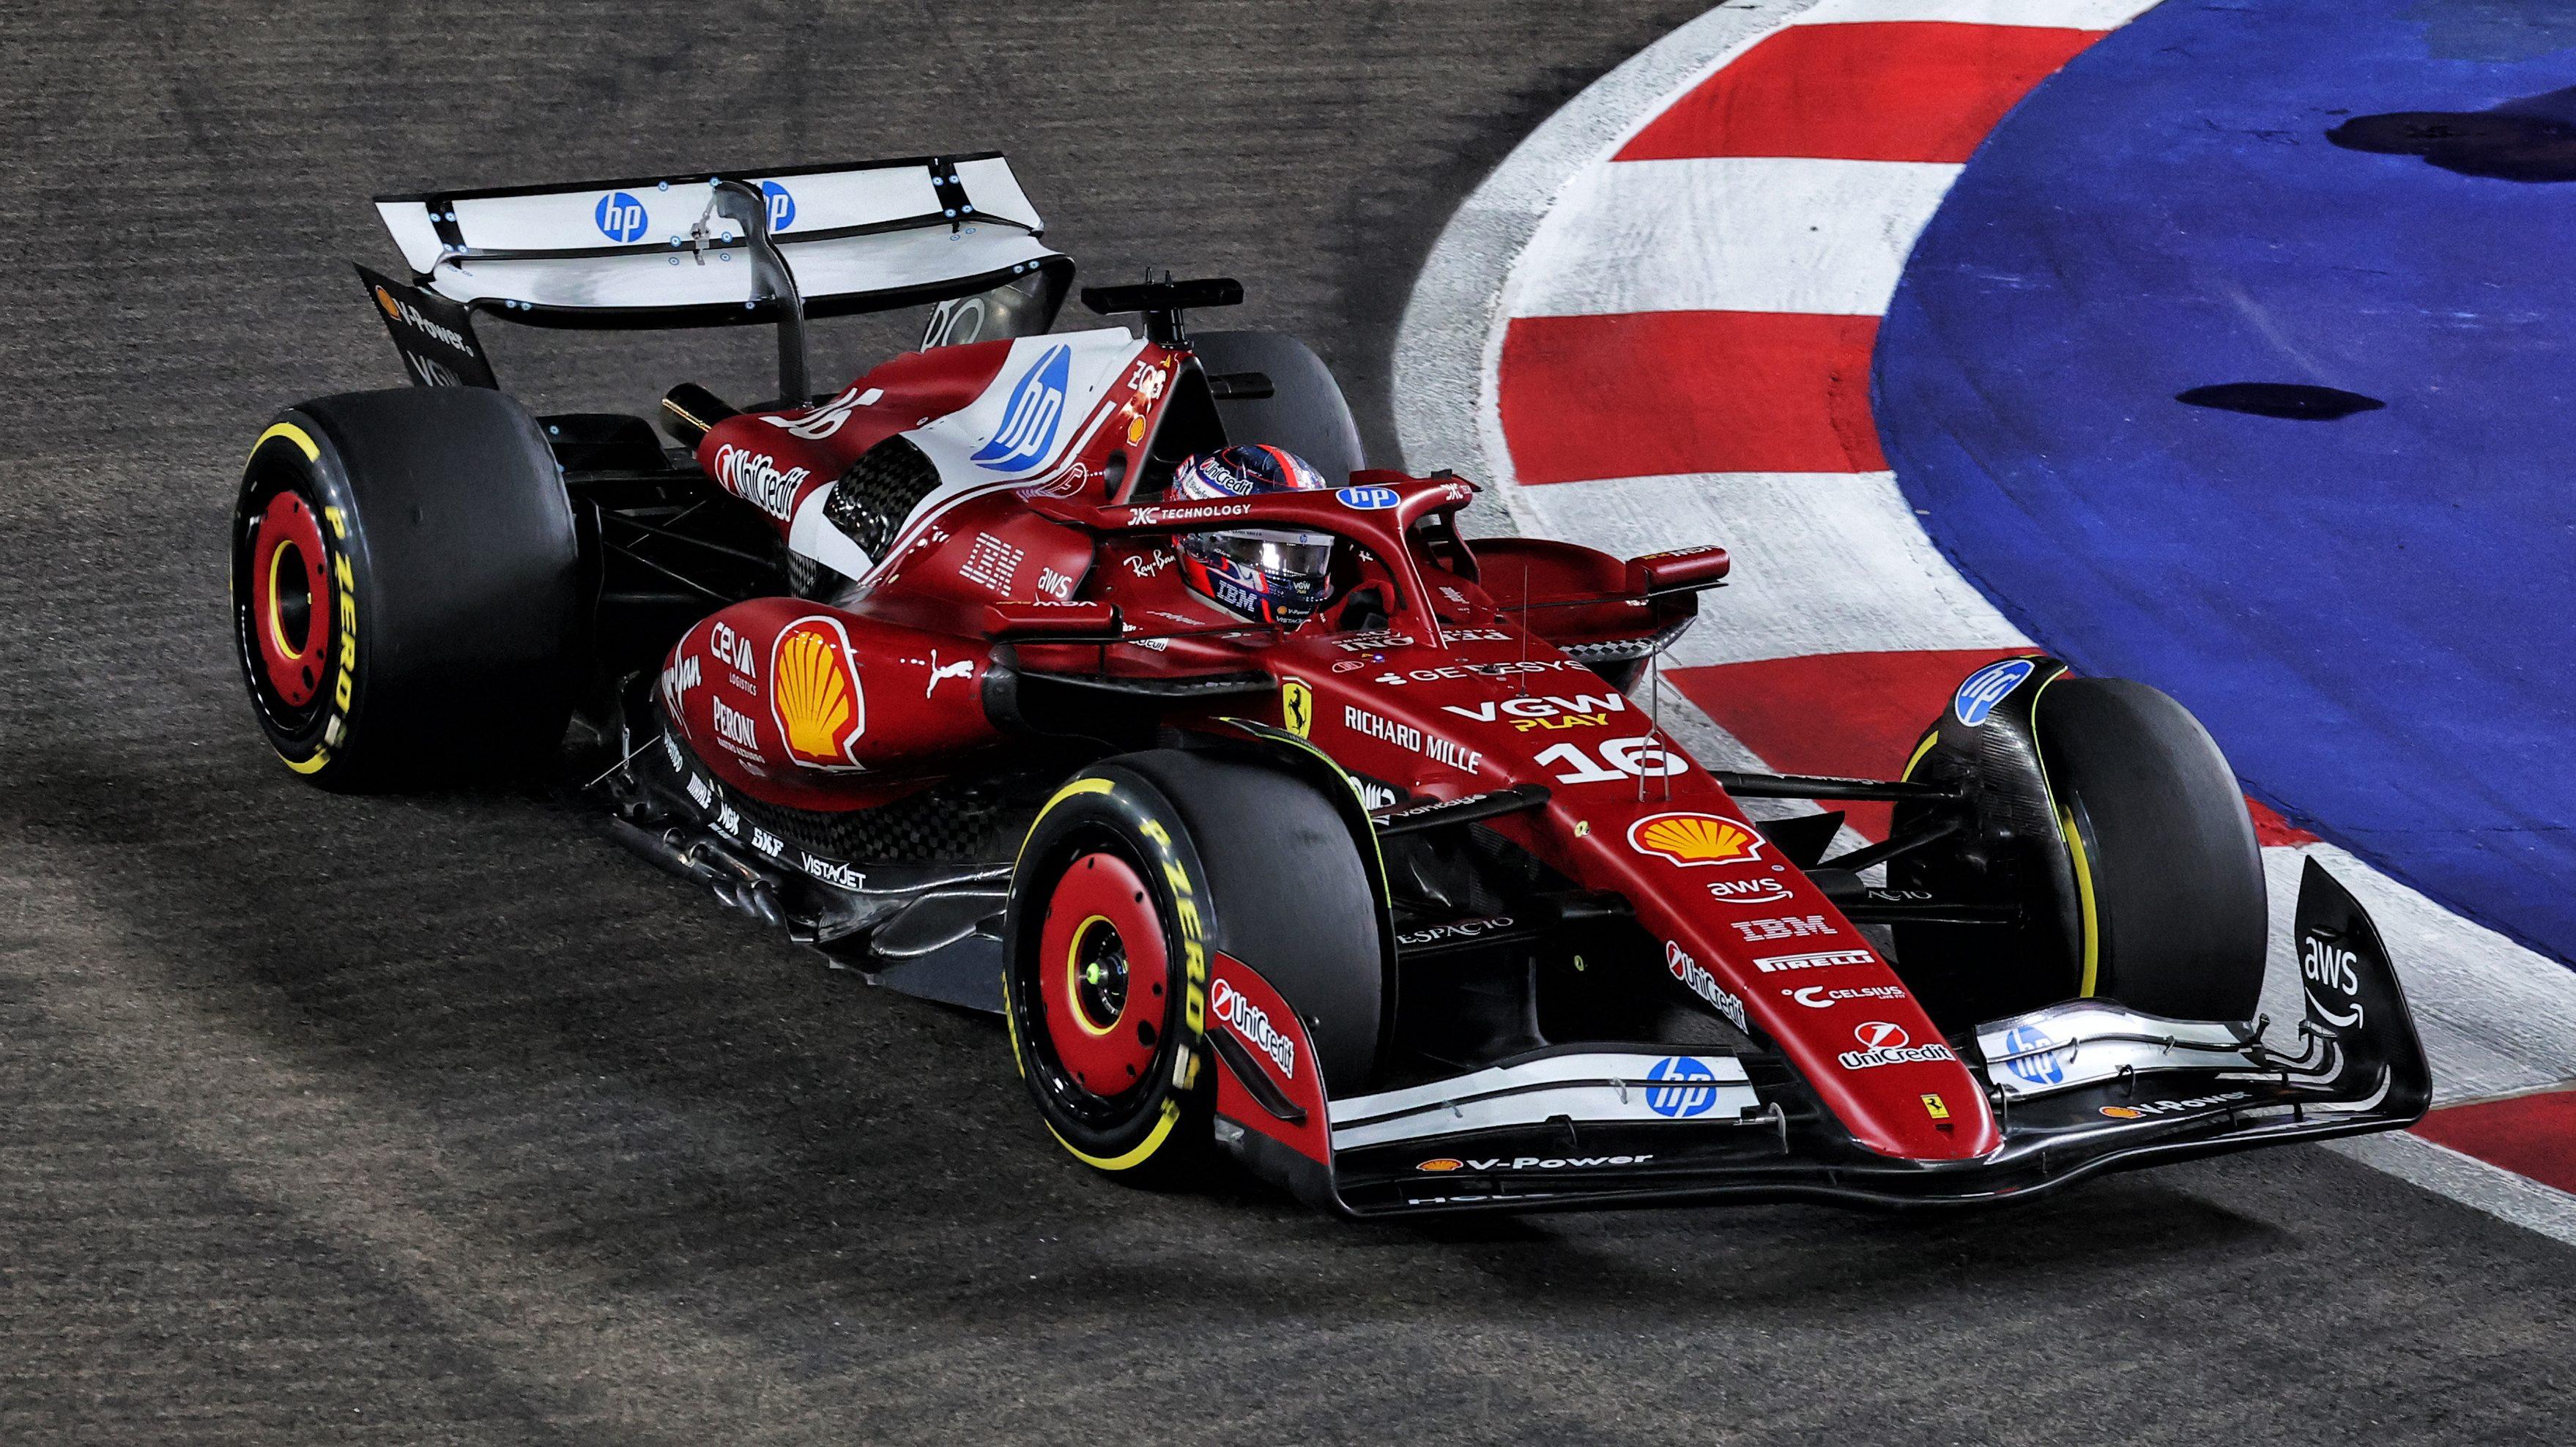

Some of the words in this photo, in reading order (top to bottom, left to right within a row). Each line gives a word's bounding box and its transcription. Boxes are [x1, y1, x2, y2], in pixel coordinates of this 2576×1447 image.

[605, 192, 642, 243] hp
[391, 297, 467, 352] V-Power
[971, 344, 1063, 464] hp
[732, 448, 811, 523] UniCredit
[1203, 461, 1254, 496] UniCredit
[1161, 504, 1252, 519] TECHNOLOGY
[1349, 486, 1391, 510] hp
[959, 532, 1025, 598] IBM
[1037, 567, 1073, 598] aws
[324, 505, 346, 540] P
[335, 550, 357, 715] ZERO
[1217, 579, 1258, 613] IBM
[729, 672, 757, 696] LOGISTICS
[713, 695, 759, 751] PERONI
[1441, 693, 1626, 723] VGW
[1509, 712, 1612, 733] PLAY
[1344, 704, 1422, 754] RICHARD
[1425, 732, 1483, 775] MILLE
[1533, 737, 1690, 784] 16
[686, 771, 713, 810] MAHLE
[717, 800, 740, 836] NGK
[751, 827, 784, 858] SKF
[1707, 877, 1783, 896] aws
[1140, 819, 1172, 849] P
[1162, 859, 1206, 1036] ZERO
[1397, 915, 1514, 945] ESPACIO
[1731, 915, 1838, 942] IBM
[1753, 950, 1876, 972] PIRELLI
[2304, 936, 2359, 996] aws
[1684, 953, 1749, 1035] UniCredit
[1231, 991, 1294, 1079] UniCredit
[1838, 1042, 1956, 1071] UniCredit
[2019, 1027, 2055, 1085] hp
[1653, 1056, 1709, 1117] hp
[2126, 1091, 2253, 1114] V-Power
[1466, 1153, 1654, 1171] V-Power
